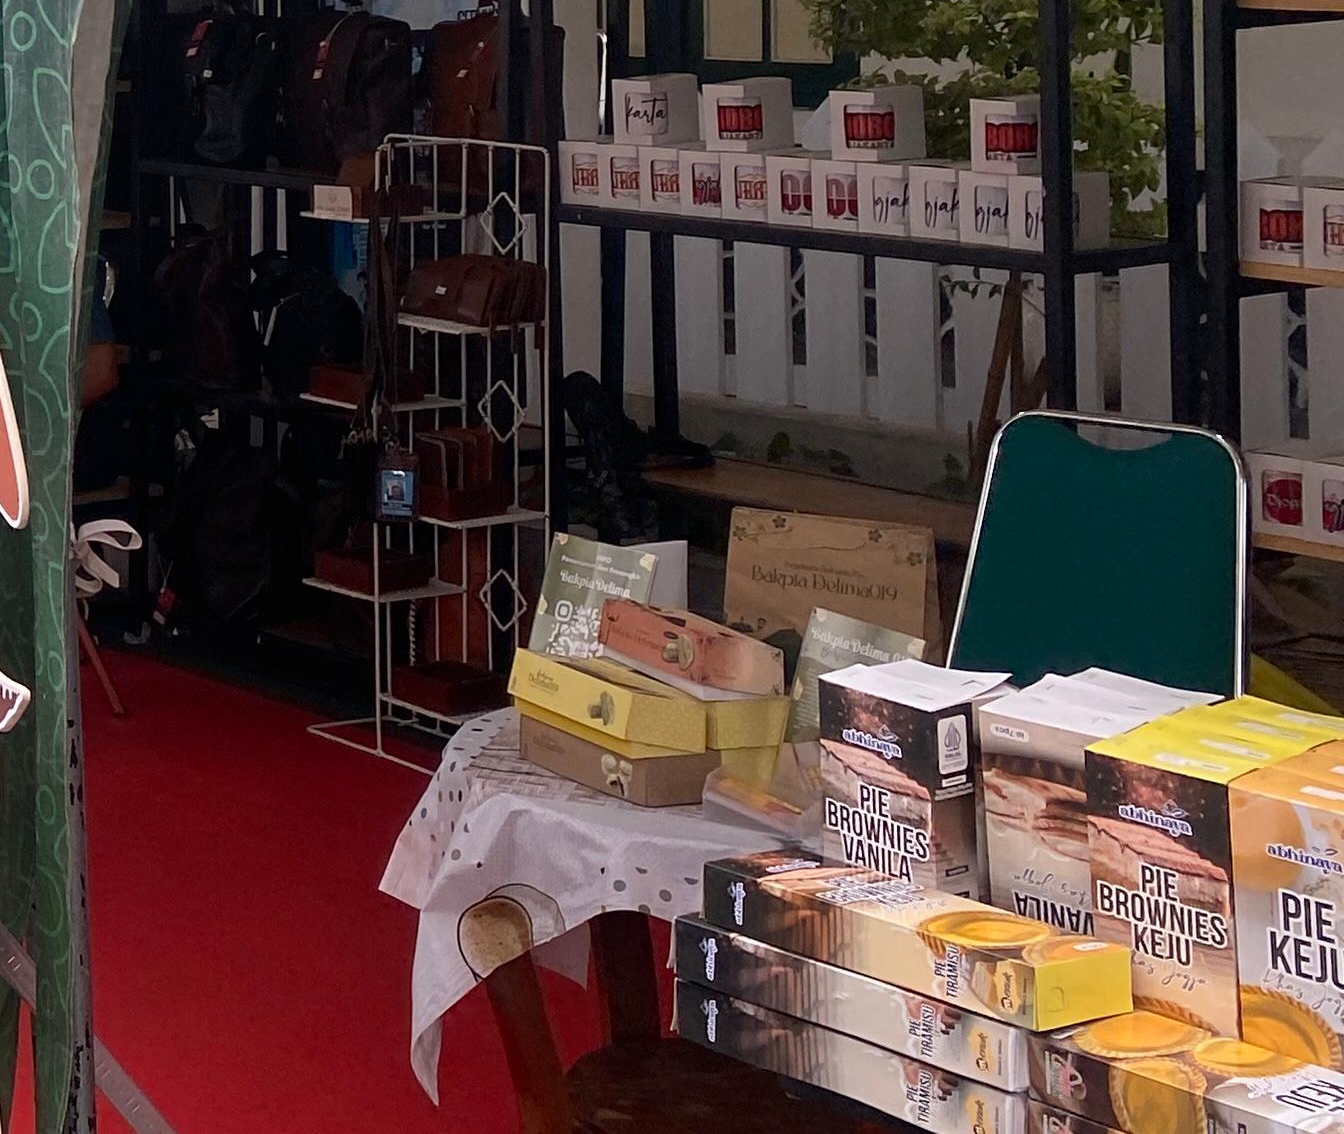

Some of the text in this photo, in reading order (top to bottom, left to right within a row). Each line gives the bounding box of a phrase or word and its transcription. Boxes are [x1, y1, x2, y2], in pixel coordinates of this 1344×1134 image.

[560, 569, 594, 589] Bakpia
[596, 578, 631, 598] Delima
[751, 564, 808, 590] Bakpia
[851, 640, 890, 663] Delima
[842, 728, 902, 759] abhinaya
[860, 785, 889, 818] PIE
[827, 800, 929, 860] BROWNIES
[1119, 805, 1193, 836] abhinaya
[843, 834, 911, 882] VANILA
[1266, 844, 1344, 874] abhinaya
[1141, 865, 1178, 902] PIE
[1099, 883, 1227, 947] BROWNIES
[1280, 890, 1335, 944] PIE
[1133, 924, 1191, 967] KEJU
[934, 959, 946, 978] PIE
[945, 944, 960, 998] TIRAMISU
[909, 1018, 922, 1037] PIE
[920, 1004, 936, 1058] TIRAMISU
[905, 1083, 919, 1103] PIE
[917, 1069, 933, 1123] TIRAMISU
